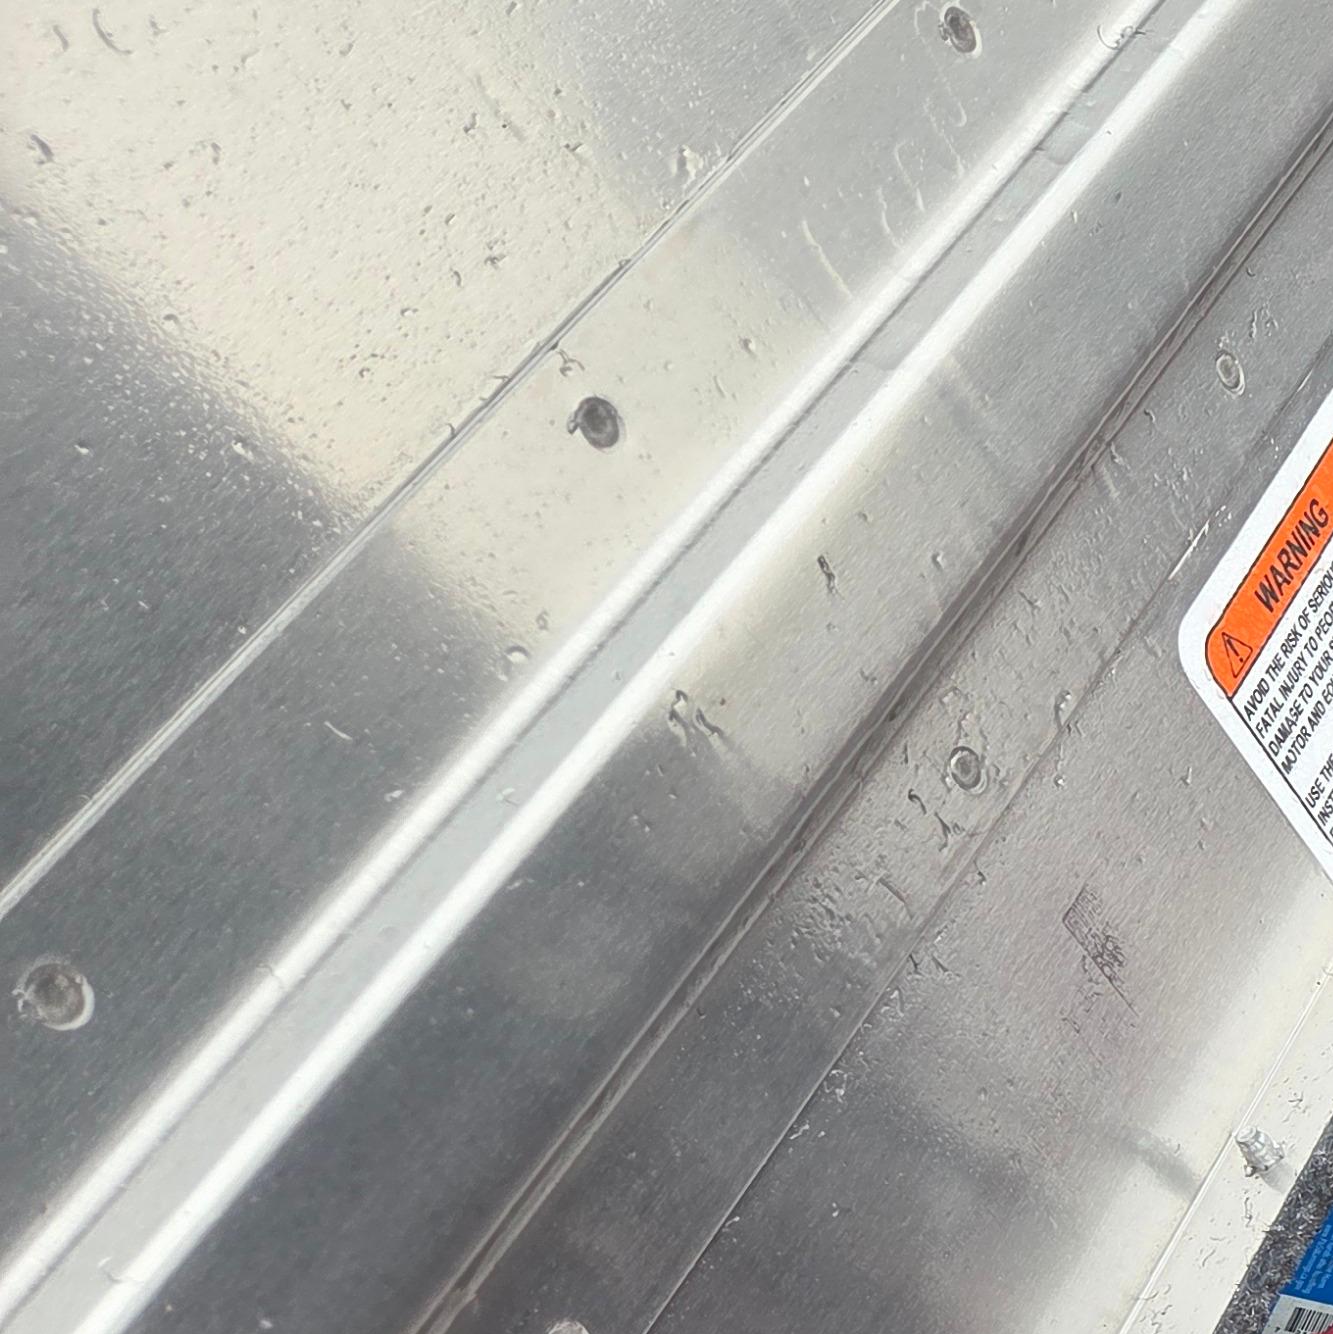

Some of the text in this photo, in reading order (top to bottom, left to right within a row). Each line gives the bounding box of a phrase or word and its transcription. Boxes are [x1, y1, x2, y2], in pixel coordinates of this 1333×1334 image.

[1254, 498, 1329, 613] WARNING
[1244, 678, 1270, 721] AVOID
[1265, 653, 1286, 682] THE
[1280, 624, 1303, 659] RISK
[1298, 607, 1311, 630] OF
[1255, 697, 1284, 739] FATAL
[1304, 636, 1318, 658] TO
[1268, 699, 1304, 757] DAMAGE
[1298, 683, 1313, 704] TO
[1308, 650, 1333, 686] YOUR
[1281, 726, 1312, 775] MOTOR
[1308, 700, 1326, 732] AND
[1305, 778, 1325, 808] USE
